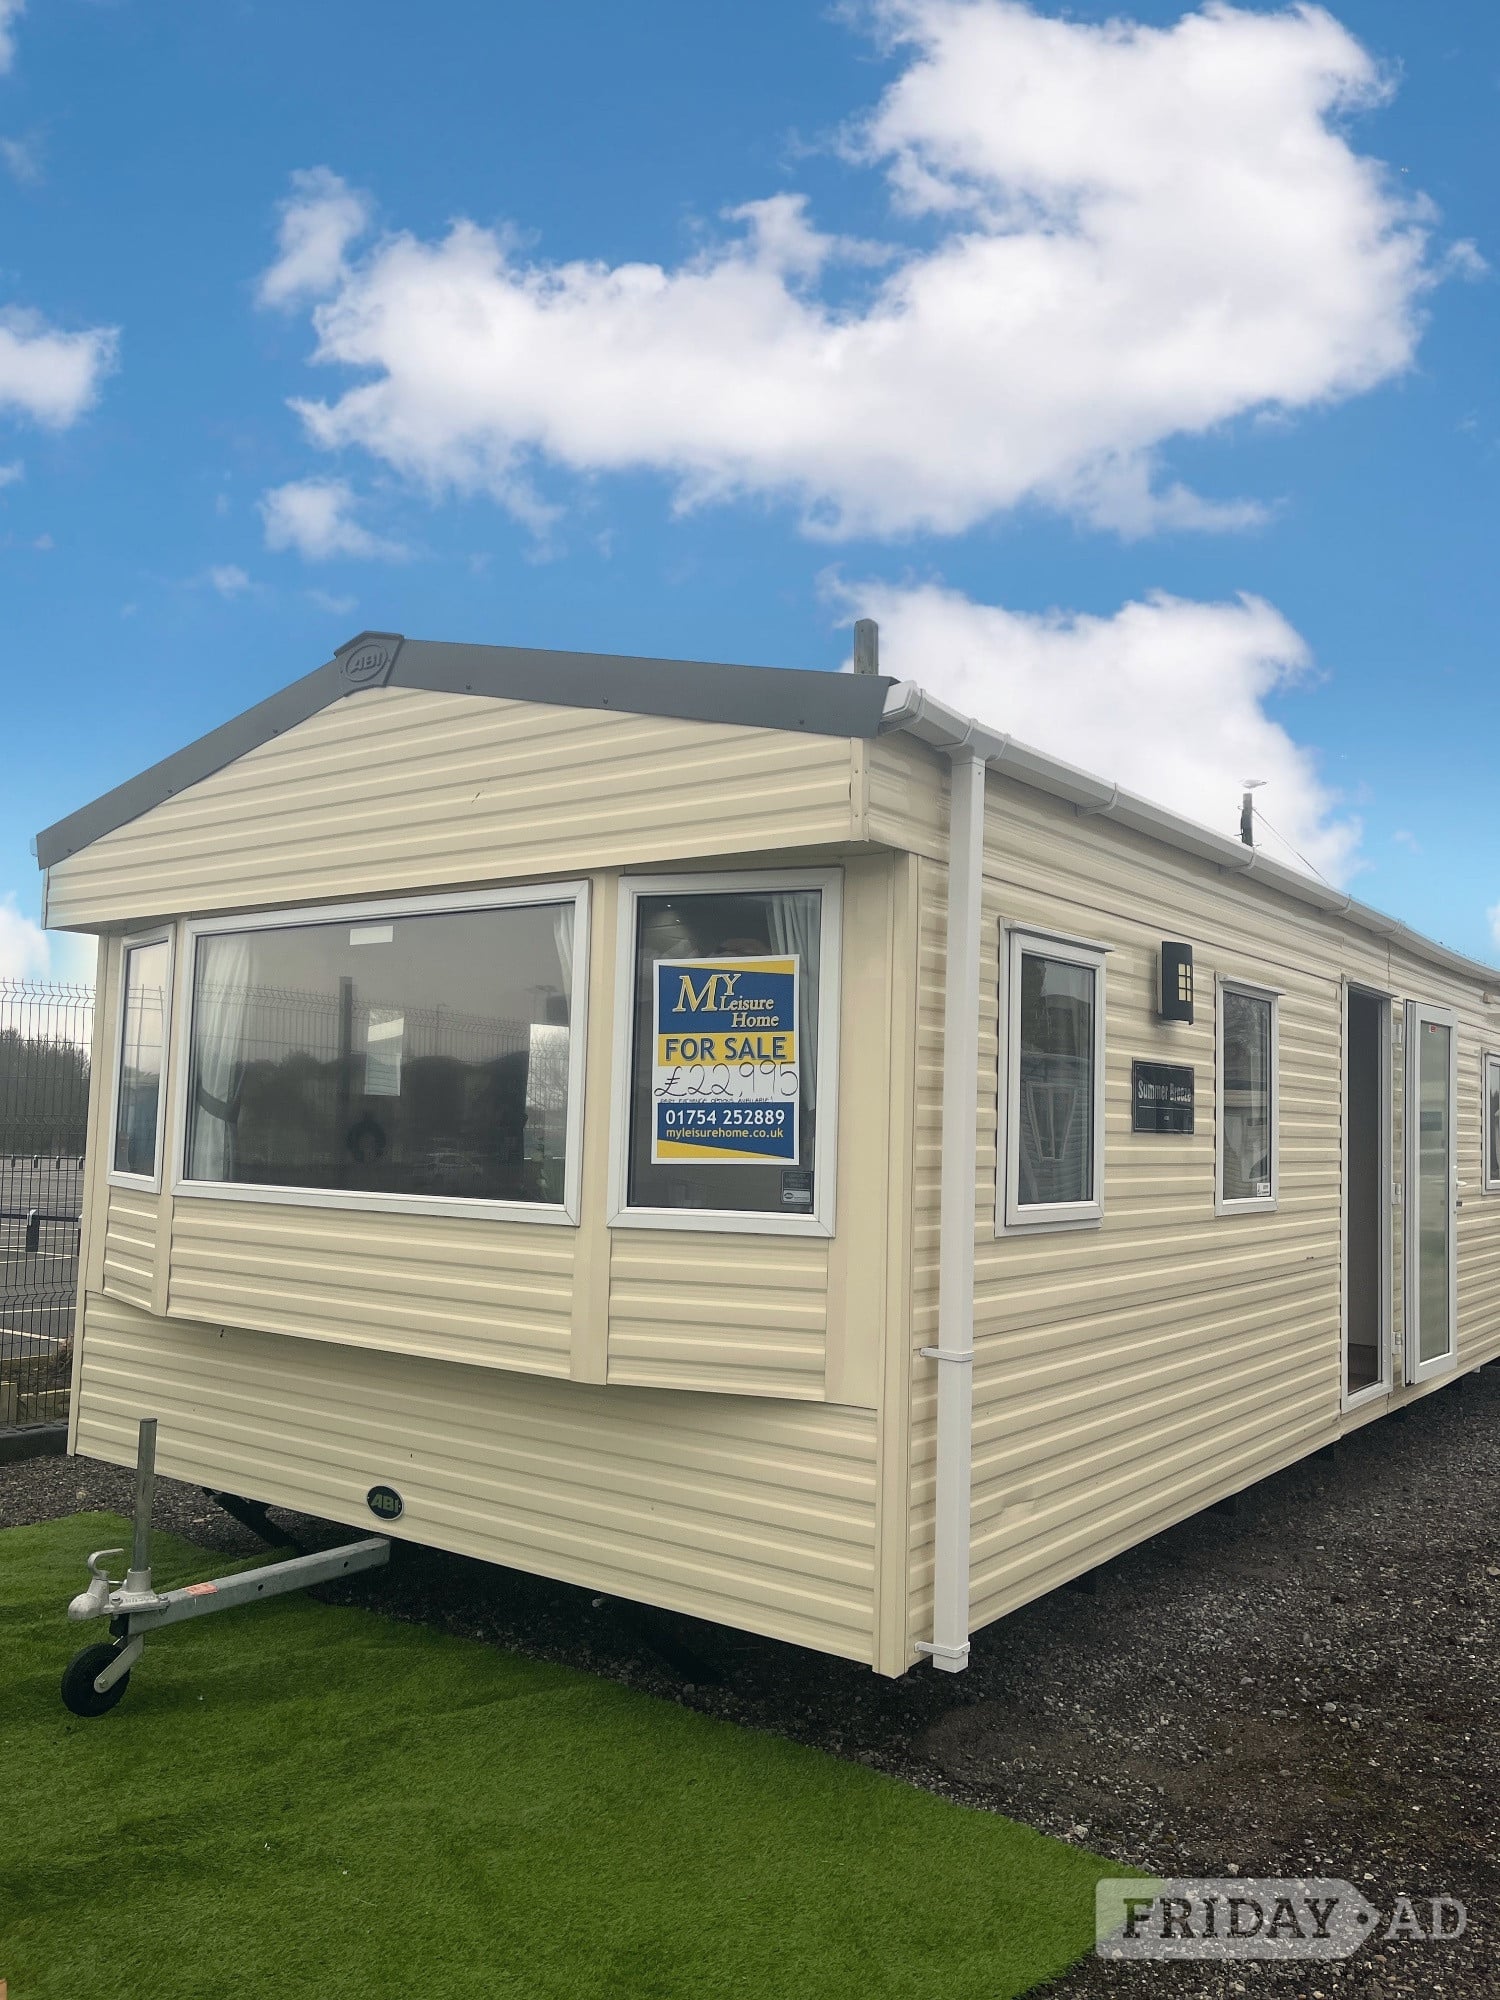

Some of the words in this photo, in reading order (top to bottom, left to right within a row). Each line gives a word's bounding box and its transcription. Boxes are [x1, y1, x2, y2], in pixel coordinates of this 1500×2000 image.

[718, 995, 775, 1011] Leisure
[731, 1012, 780, 1028] Home
[665, 1037, 716, 1061] FOR
[724, 1036, 788, 1060] SALE
[654, 1059, 799, 1097] £22,995
[1138, 1080, 1169, 1101] Summer
[665, 1109, 717, 1125] 01754
[722, 1109, 785, 1125] 252889
[666, 1127, 784, 1140] myleisurehome.co.uk
[370, 1493, 400, 1513] ABI
